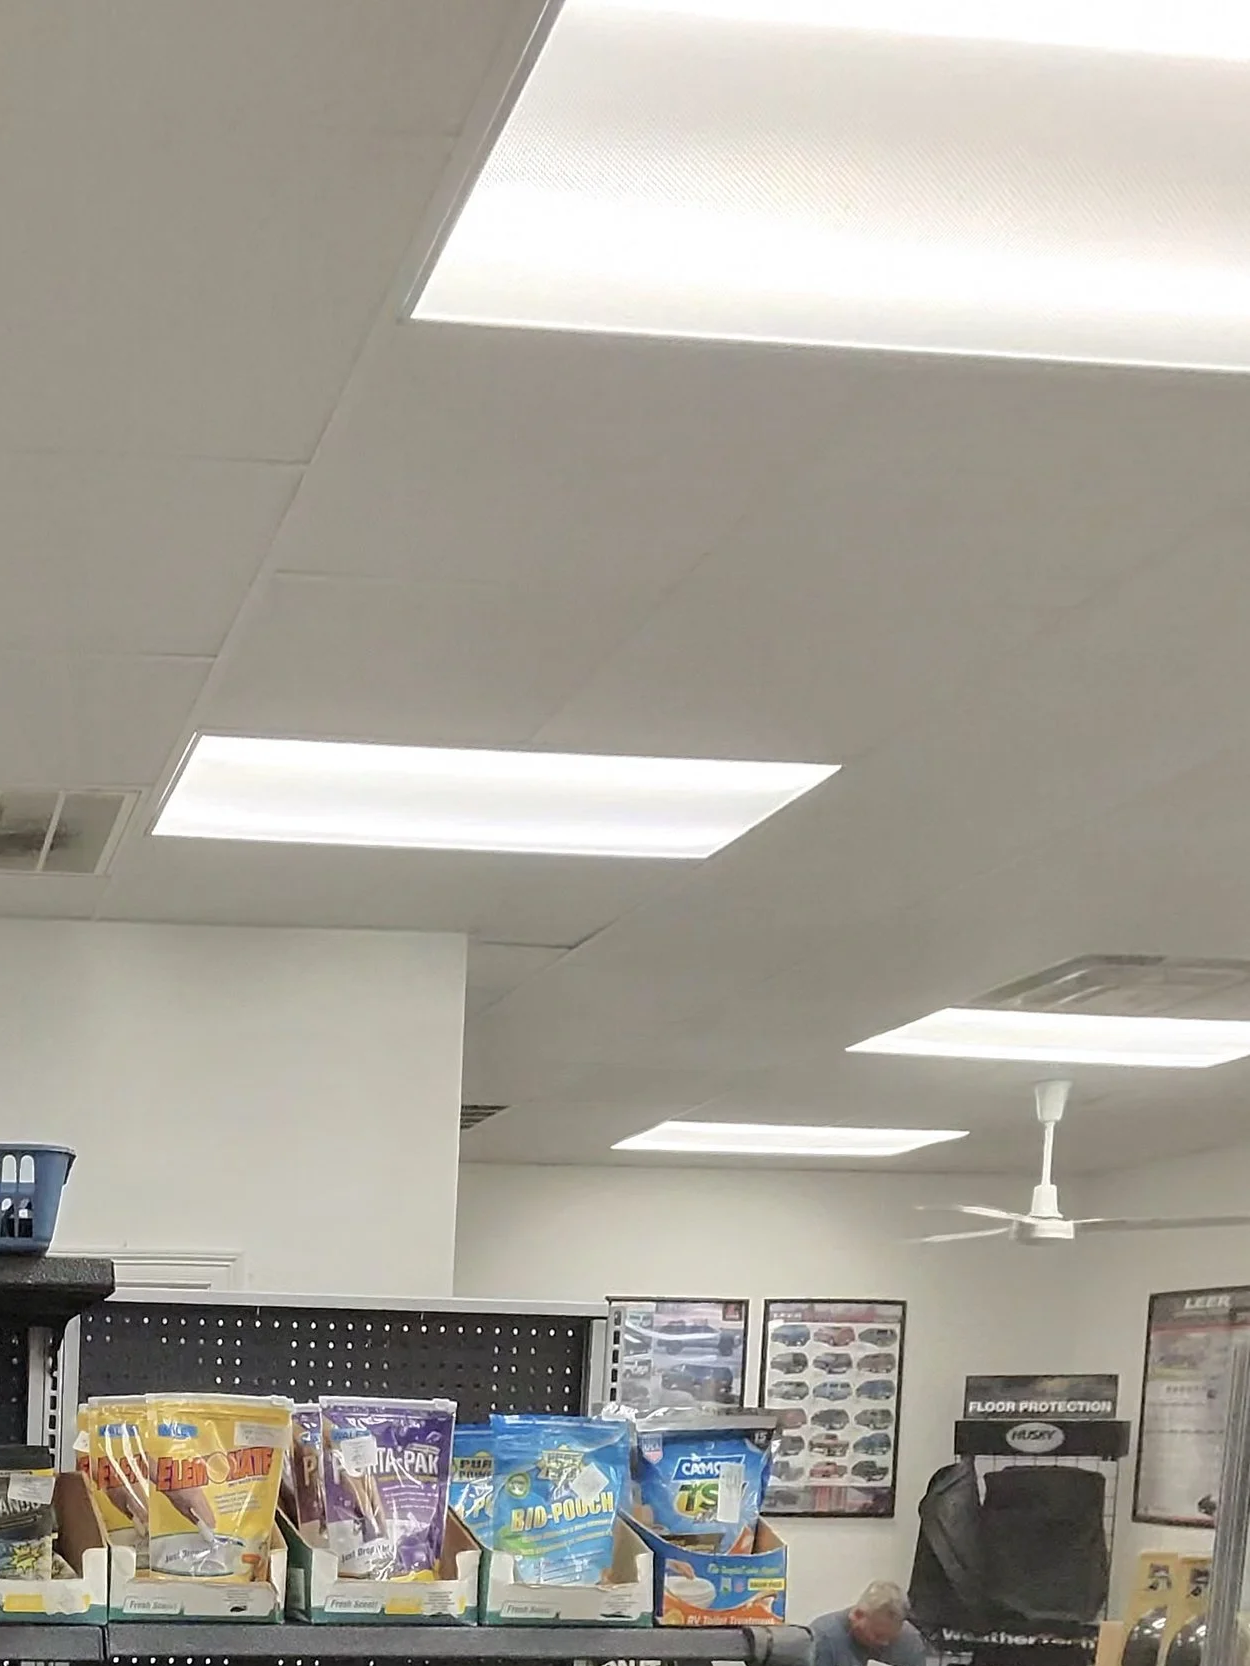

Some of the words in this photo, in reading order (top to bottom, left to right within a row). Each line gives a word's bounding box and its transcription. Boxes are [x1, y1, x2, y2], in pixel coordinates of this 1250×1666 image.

[968, 1401, 1016, 1413] FLOOR
[1018, 1401, 1112, 1413] PROTECTION
[1011, 1430, 1056, 1441] HUSKY
[681, 1462, 721, 1476] CAMC
[679, 1481, 730, 1512] TS
